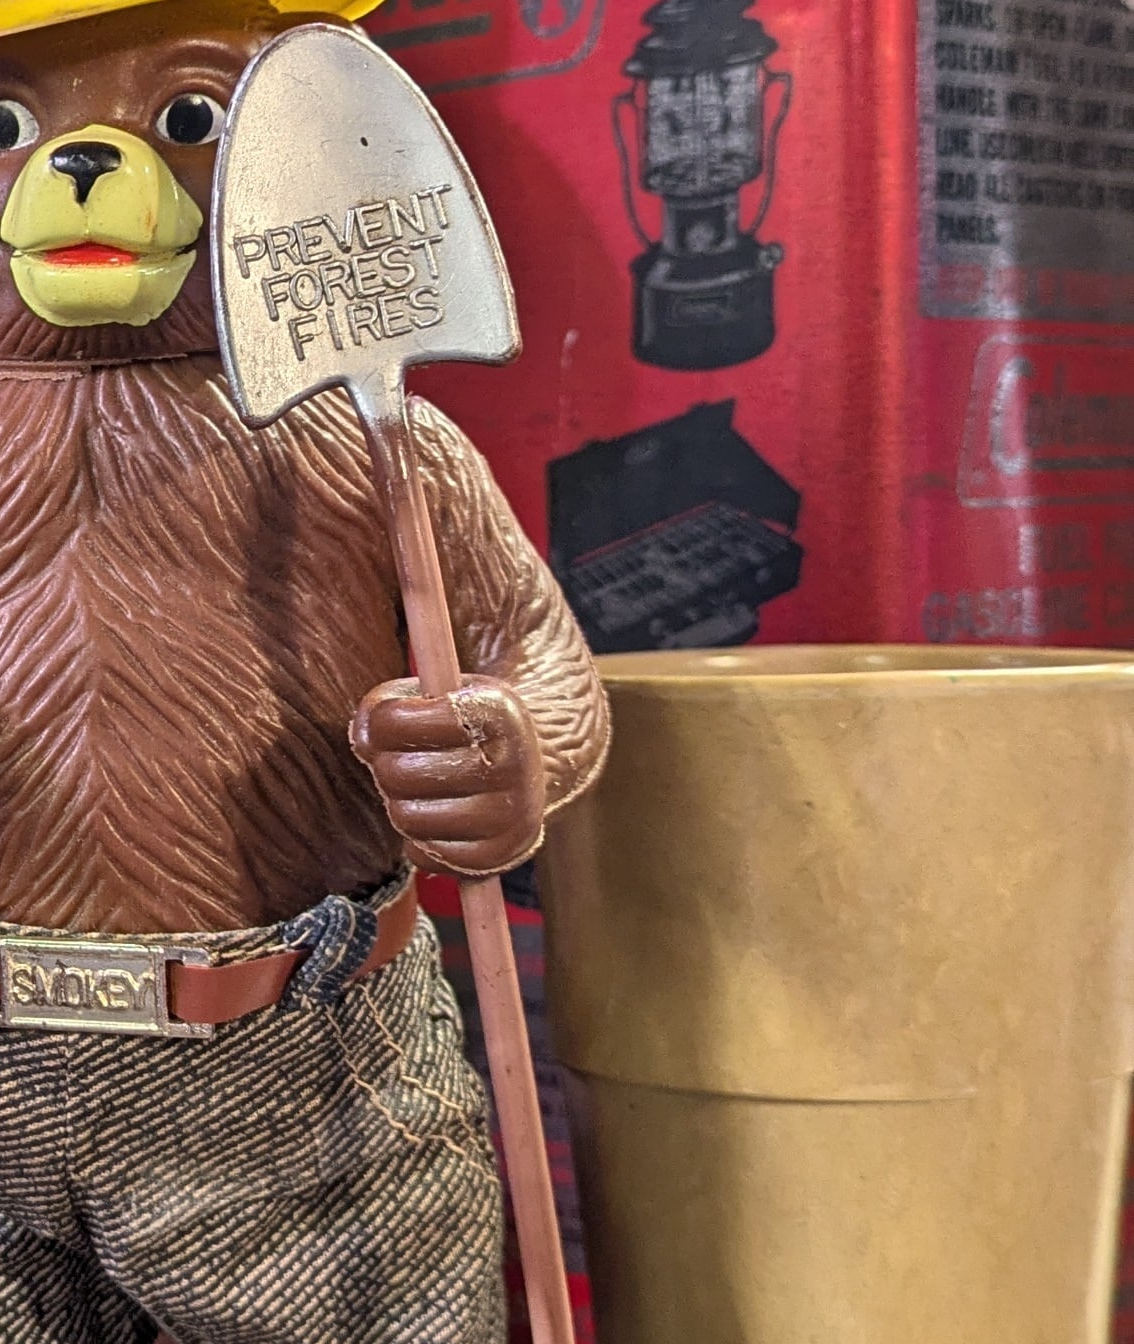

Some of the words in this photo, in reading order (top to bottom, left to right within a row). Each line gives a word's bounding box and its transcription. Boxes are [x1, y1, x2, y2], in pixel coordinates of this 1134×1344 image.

[233, 183, 452, 279] PREVENT
[261, 234, 444, 321] FOREST
[288, 285, 444, 362] FIRES
[12, 962, 156, 1011] SMOKEY
